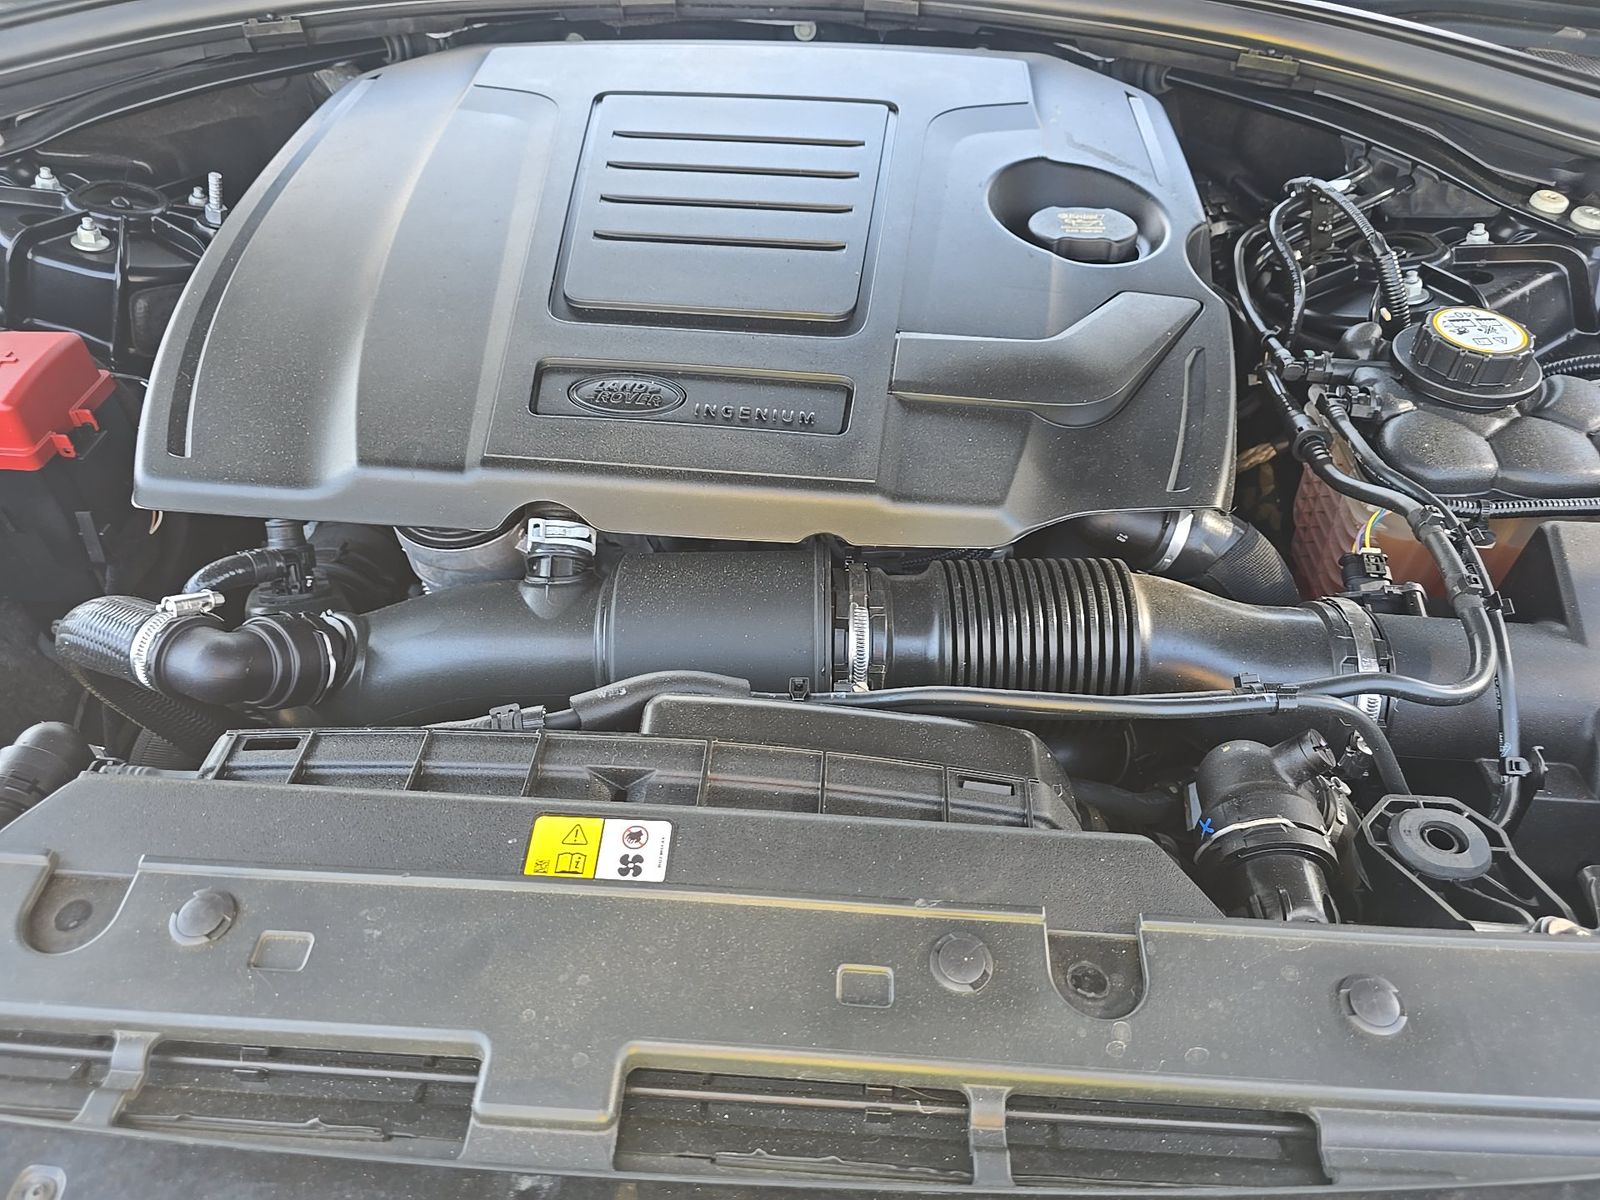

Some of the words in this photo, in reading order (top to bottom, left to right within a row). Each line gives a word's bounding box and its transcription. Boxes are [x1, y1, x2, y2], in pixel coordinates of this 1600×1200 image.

[594, 380, 649, 393] LAND
[595, 391, 663, 407] ROVER
[694, 402, 816, 425] INGENIUM
